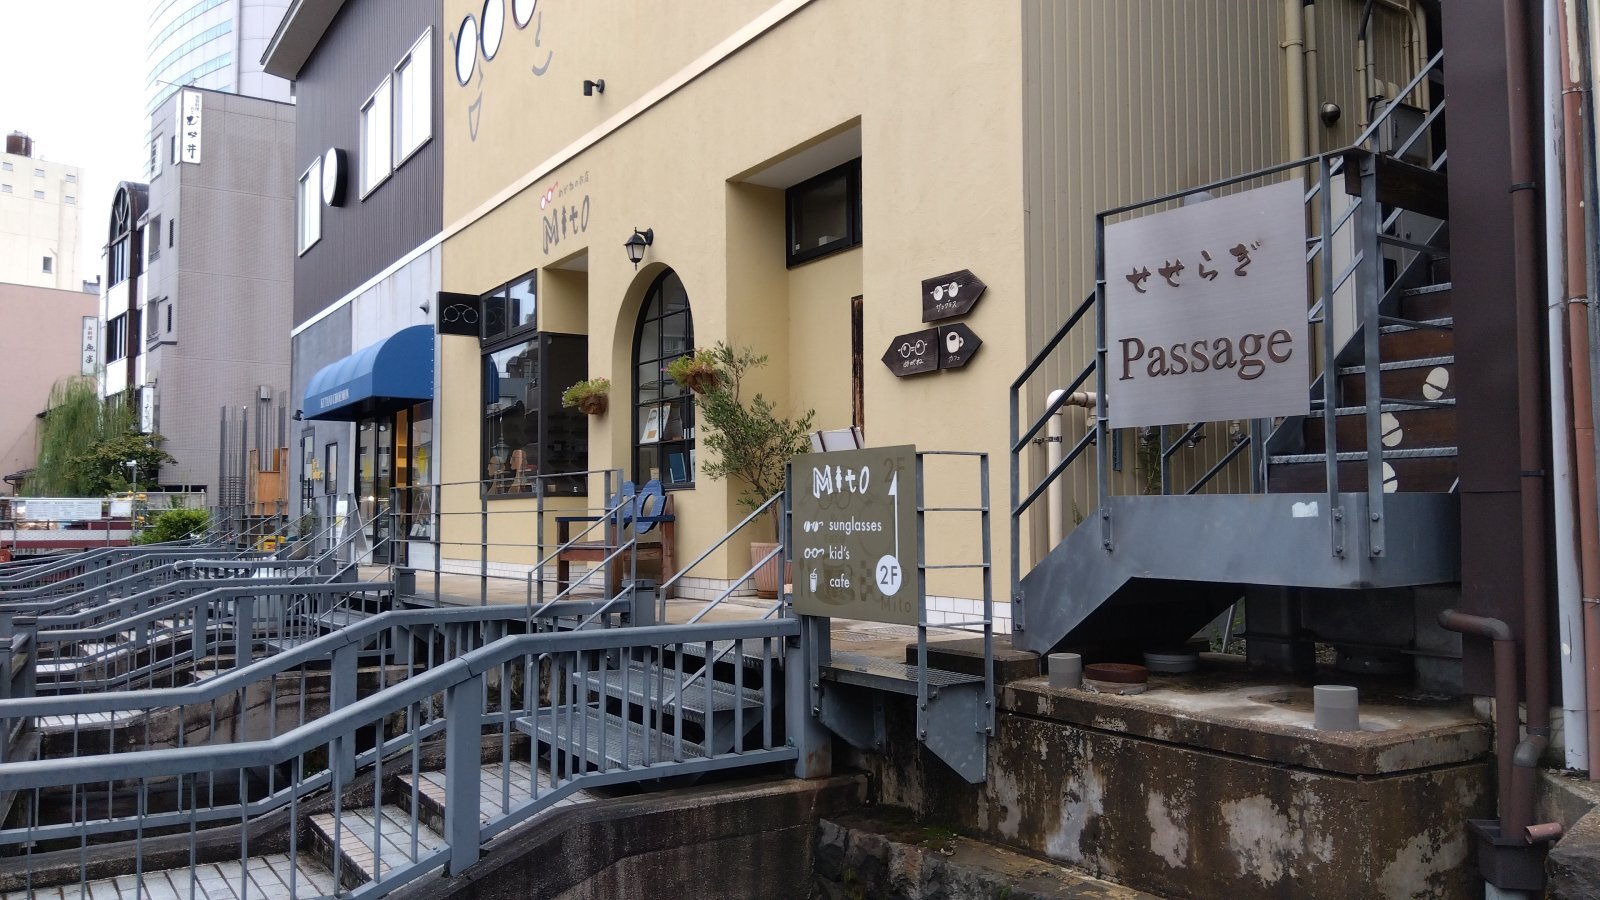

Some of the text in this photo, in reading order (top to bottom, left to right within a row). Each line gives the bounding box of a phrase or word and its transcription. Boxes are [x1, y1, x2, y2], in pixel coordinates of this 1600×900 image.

[1126, 239, 1262, 293] せせらぎ
[1118, 329, 1293, 381] Passage
[829, 516, 882, 535] sunglasses
[829, 545, 850, 560] kid's
[829, 573, 850, 588] cafe
[879, 565, 898, 586] 2F
